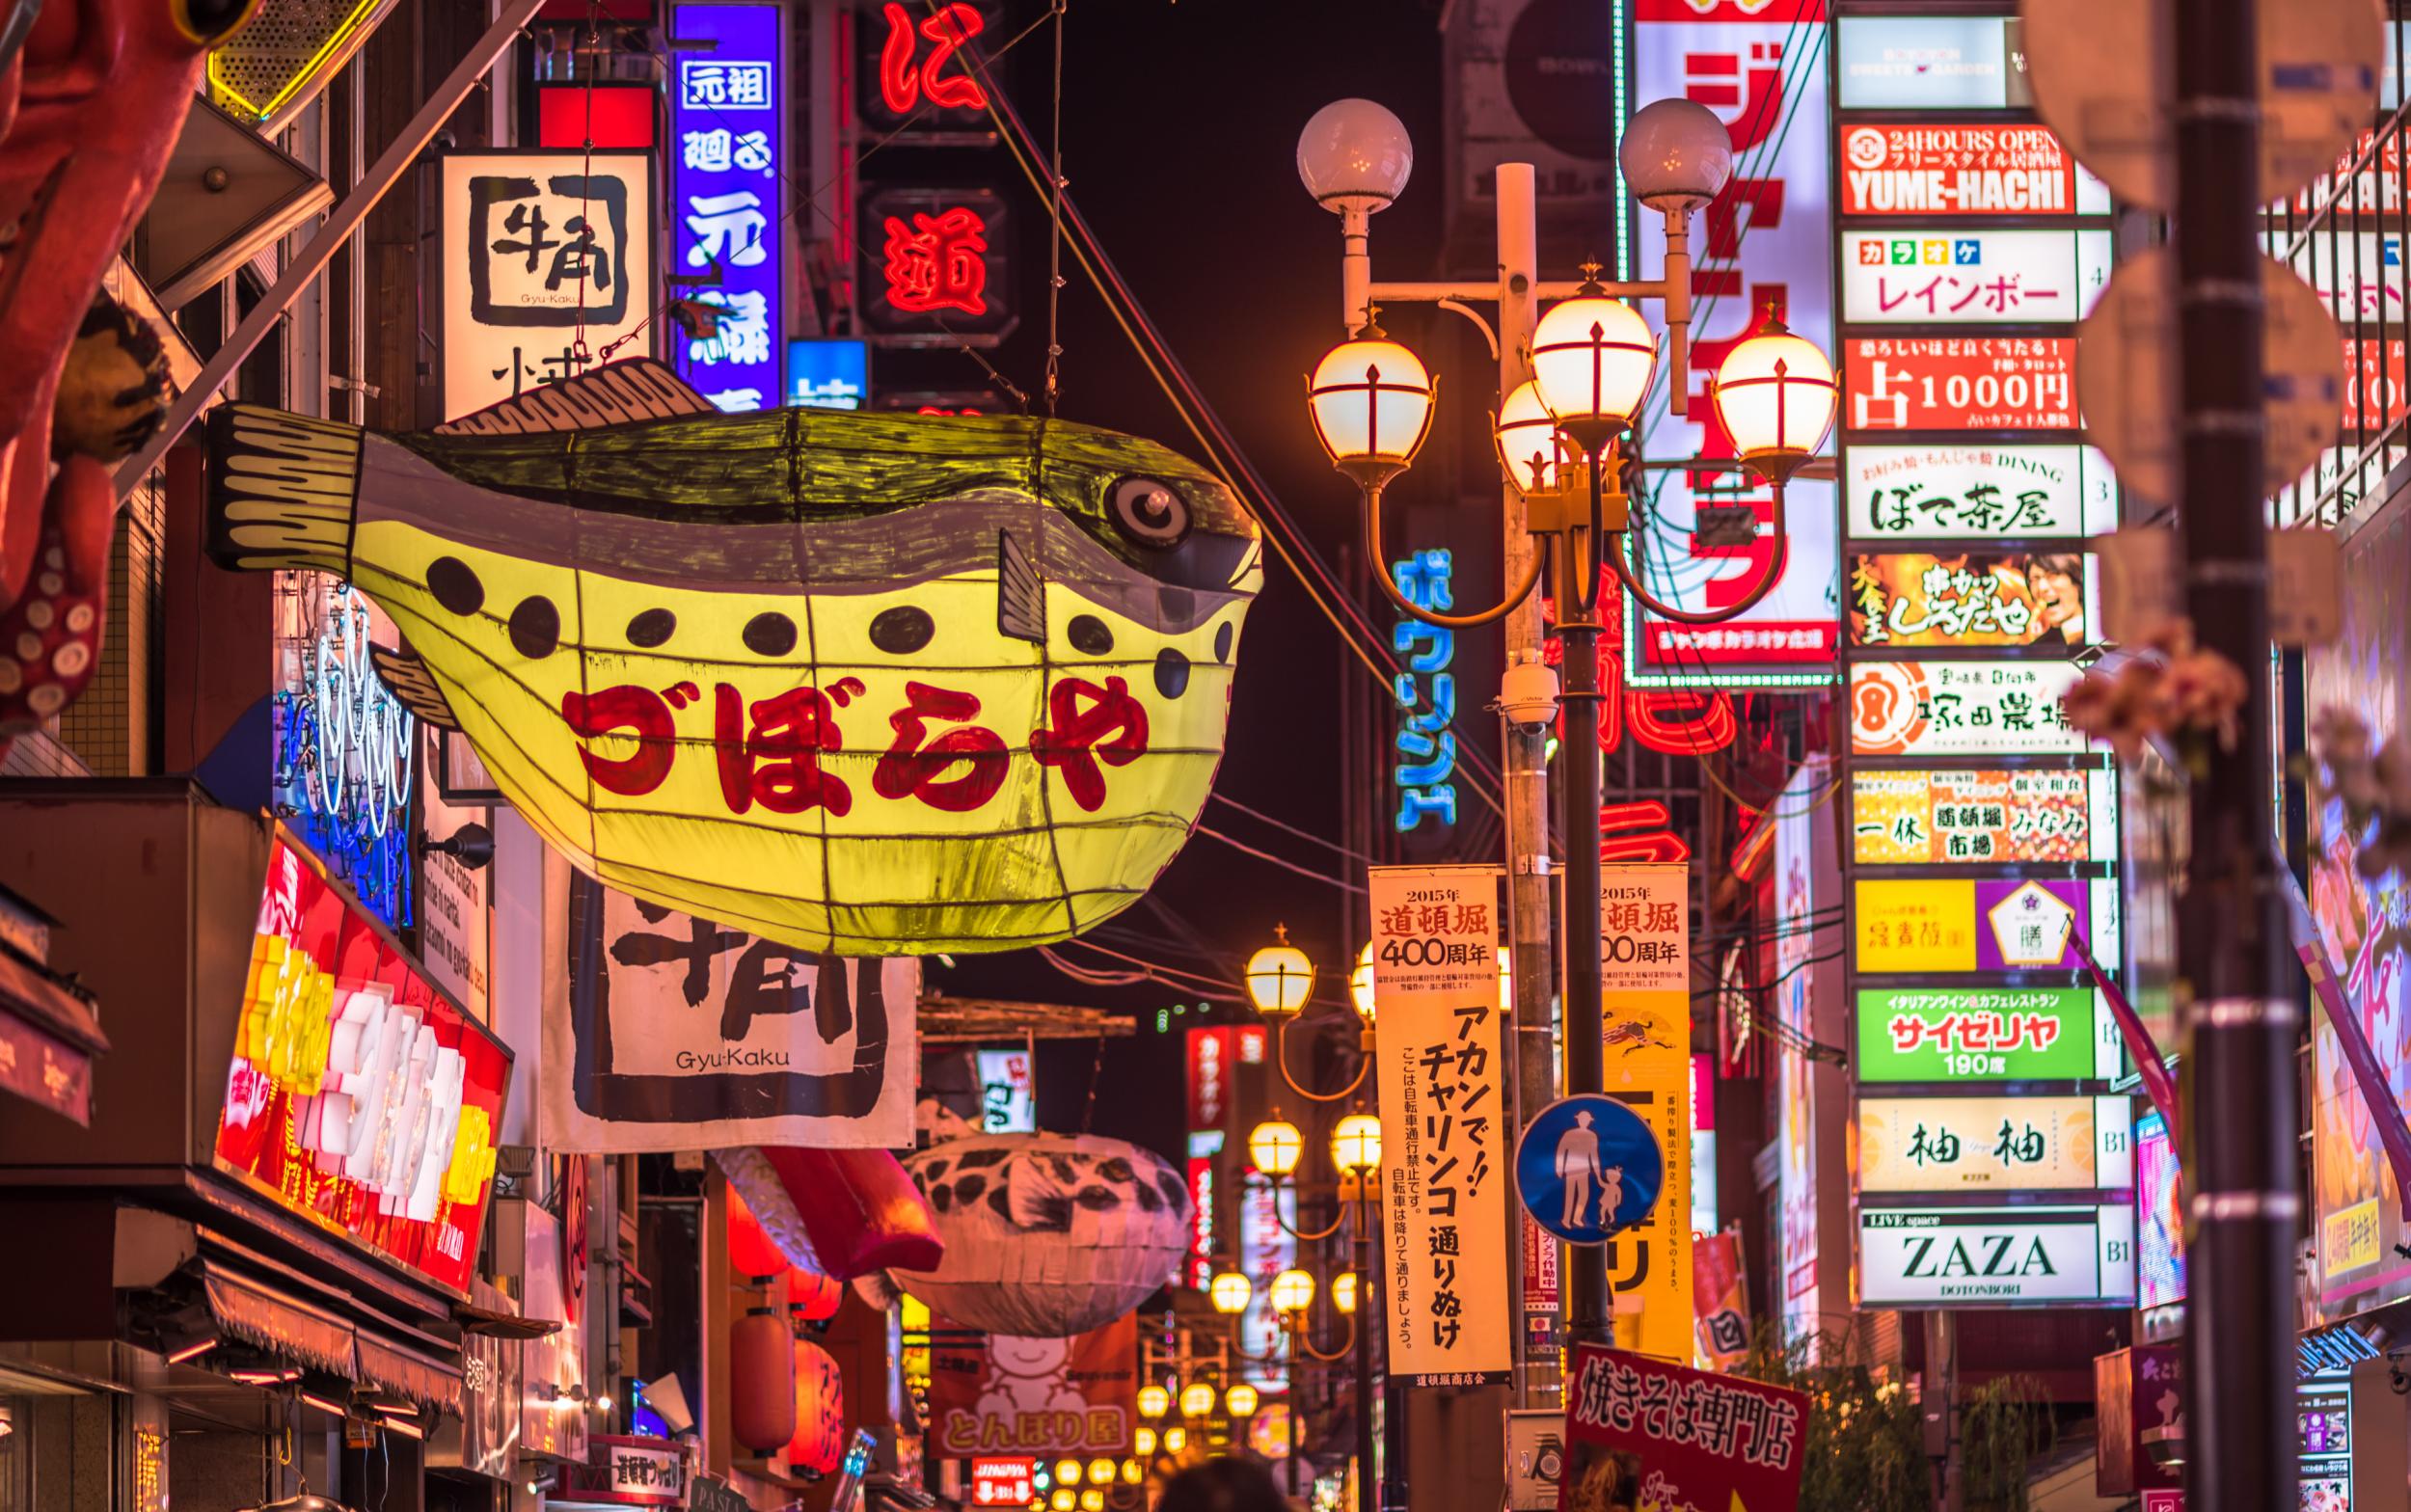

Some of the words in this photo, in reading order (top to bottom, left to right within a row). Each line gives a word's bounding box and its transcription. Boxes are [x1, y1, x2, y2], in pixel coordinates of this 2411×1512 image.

[690, 67, 764, 103] 元祖
[682, 128, 772, 172] 廻る
[1889, 129, 1994, 152] 24HOURS
[1999, 129, 2060, 152] OPEN
[1848, 169, 2066, 211] YUME-HACHI
[491, 202, 611, 292] 牛角
[1861, 241, 1980, 264] カラオケ
[521, 293, 581, 307] Gyu-Kaku
[1878, 273, 2059, 314] レインボー
[1853, 360, 1914, 430] 占
[1921, 372, 2070, 411] 1000円
[1997, 452, 2065, 484] DINING
[562, 676, 1150, 817] づぼらや
[1856, 816, 1926, 845] 一休
[2012, 812, 2085, 836] みなみ
[1949, 834, 1991, 856] 市場
[1406, 889, 1460, 903] 2015年
[1601, 887, 1651, 900] 2015年
[1379, 904, 1489, 937] 道頓堀
[1601, 902, 1680, 933] 頓堀
[1380, 937, 1490, 967] 400周年
[1601, 935, 1680, 964] 00周年
[1890, 1013, 2058, 1049] サイゼリヤ
[676, 1047, 789, 1072] Gyu-Kaku
[1944, 1055, 2006, 1075] 190席
[1402, 1047, 1422, 1214] ここは自転車通行禁止です。
[2104, 1131, 2126, 1153] B1
[1870, 1214, 1906, 1228] LIVE
[1908, 1215, 1940, 1229] space
[1392, 1168, 1412, 1349] 自転車は降りて通りましょう。
[1902, 1235, 2058, 1278] ZAZA
[2106, 1240, 2129, 1262] B1
[1416, 1371, 1486, 1388] 道頓堀商店会
[1576, 1355, 1800, 1470] 焼きそば専門店
